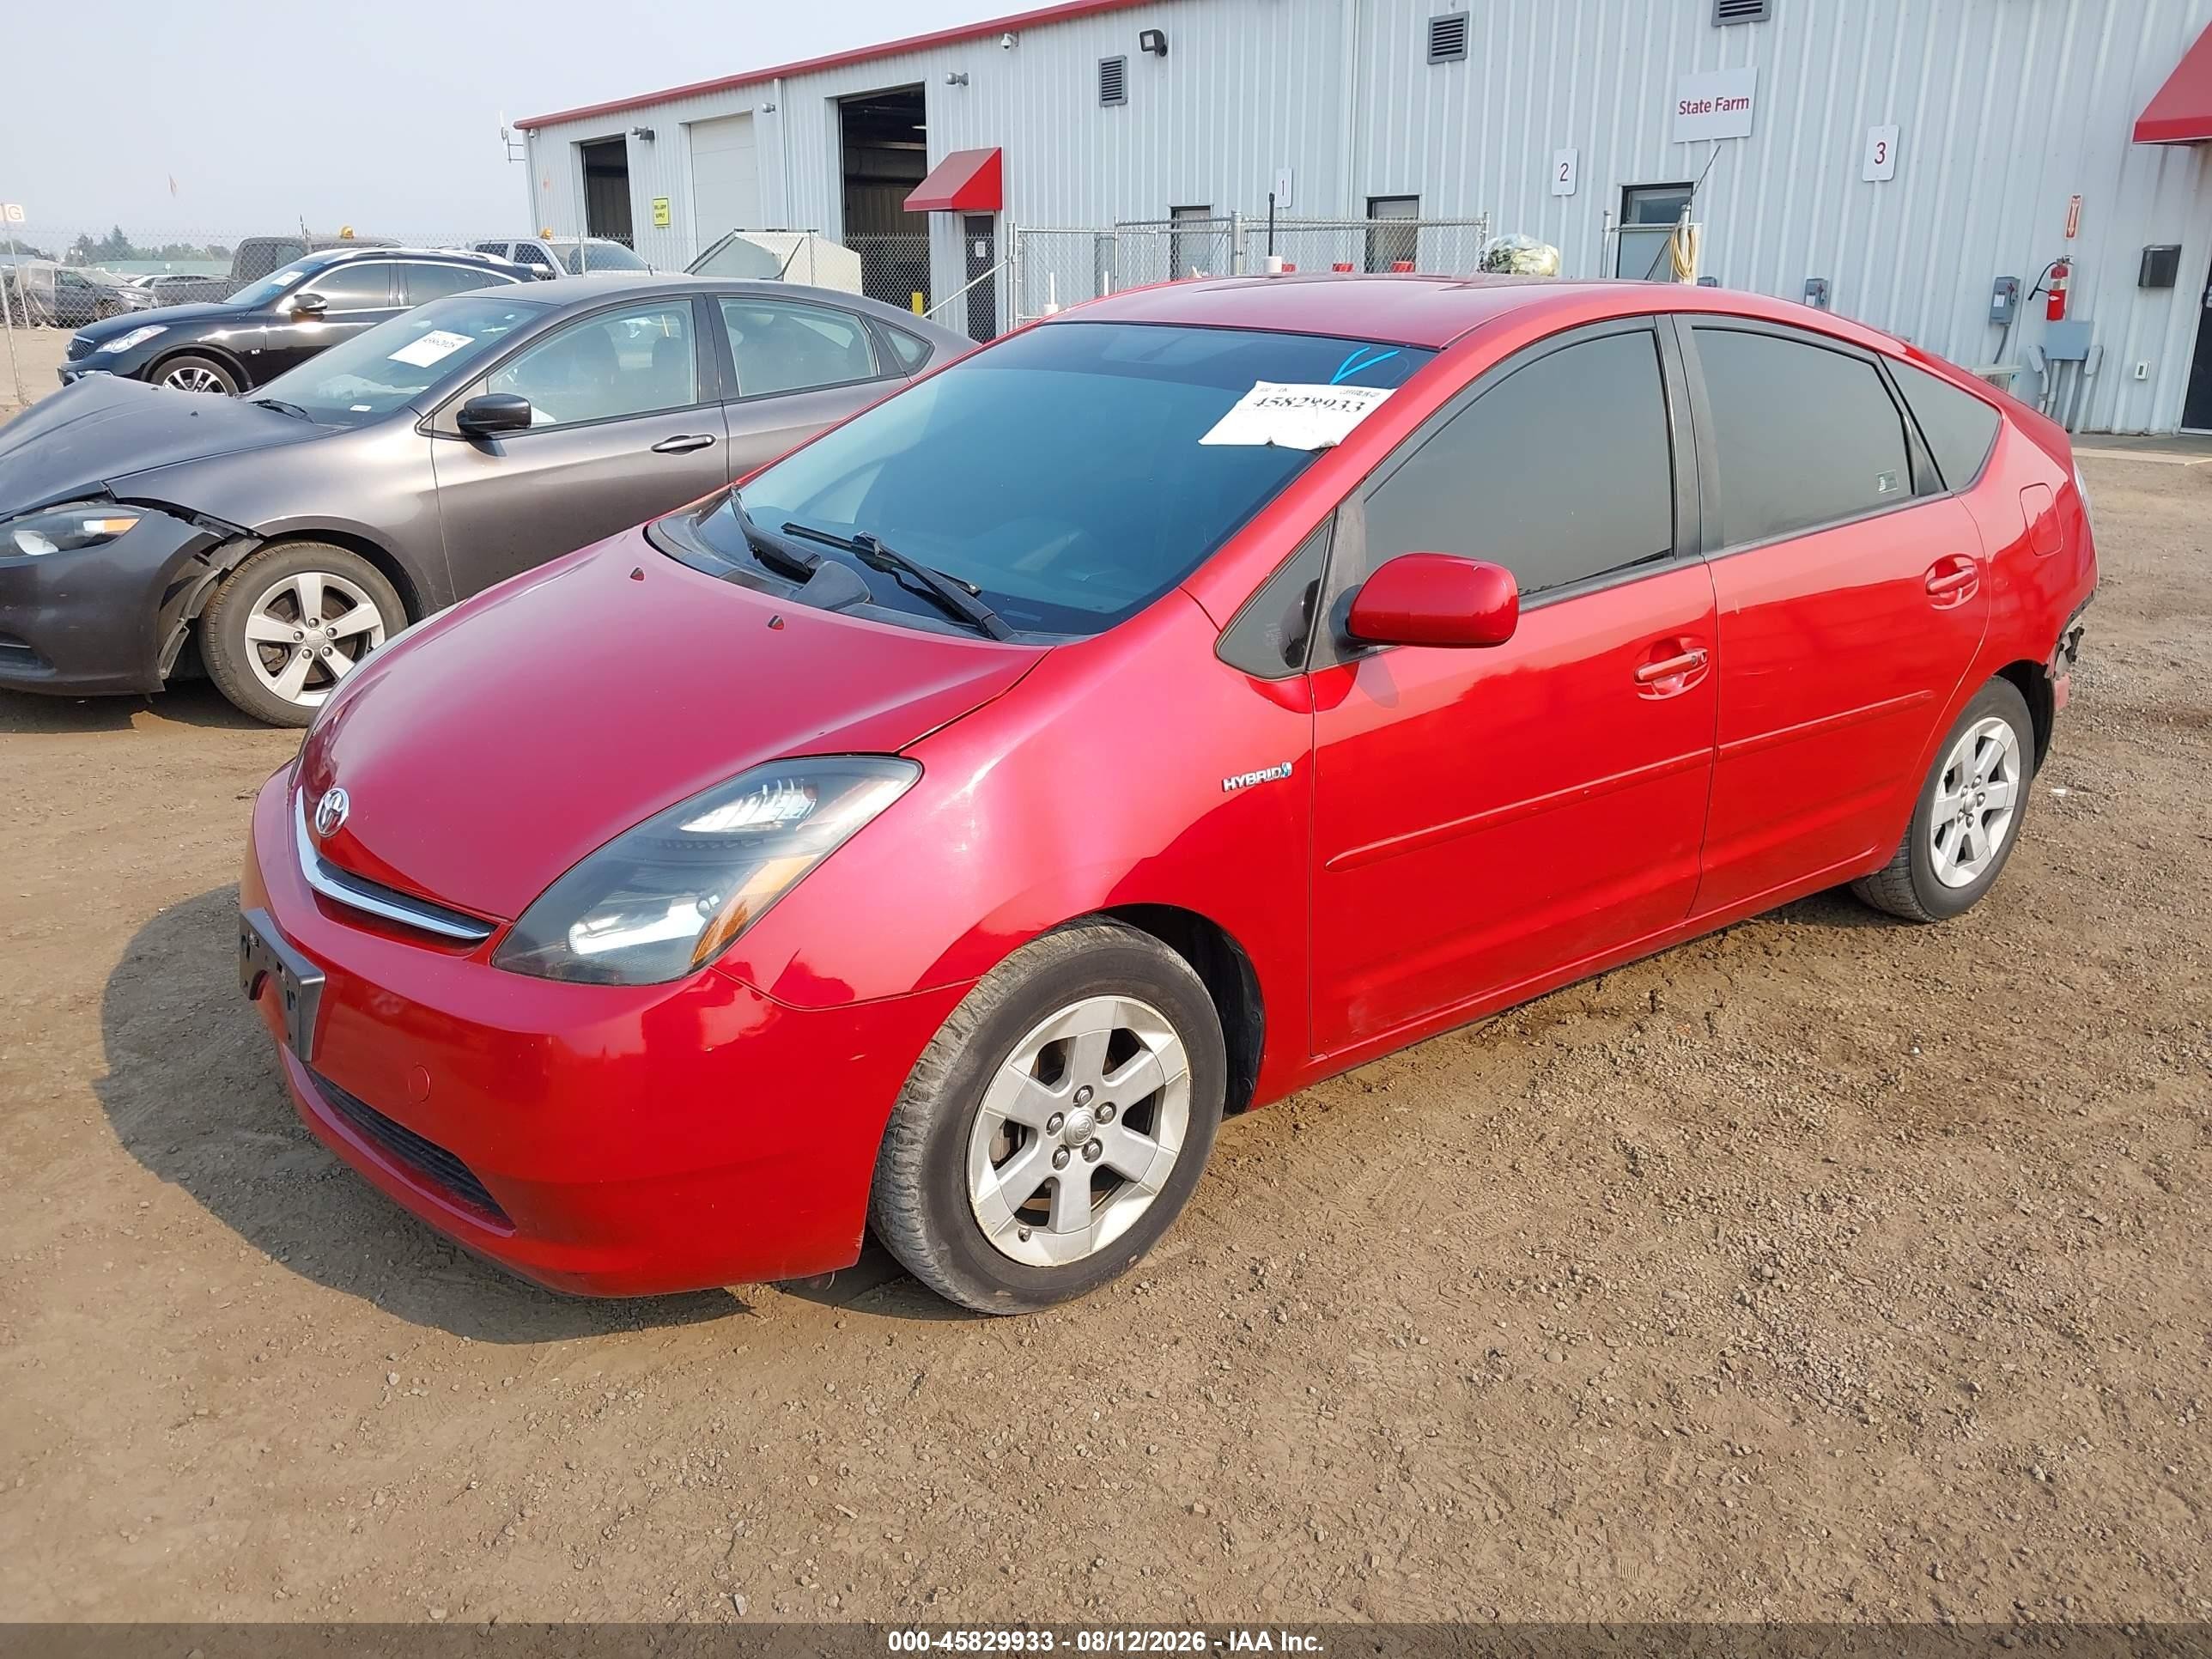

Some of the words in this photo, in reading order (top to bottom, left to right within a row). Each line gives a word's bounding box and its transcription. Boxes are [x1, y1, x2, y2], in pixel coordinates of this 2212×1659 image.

[1678, 99, 1711, 115] State
[1715, 96, 1750, 112] Farm
[1874, 141, 1887, 165] 3
[1559, 161, 1569, 182] 2
[8, 205, 22, 221] G
[1222, 766, 1282, 792] HYBRID
